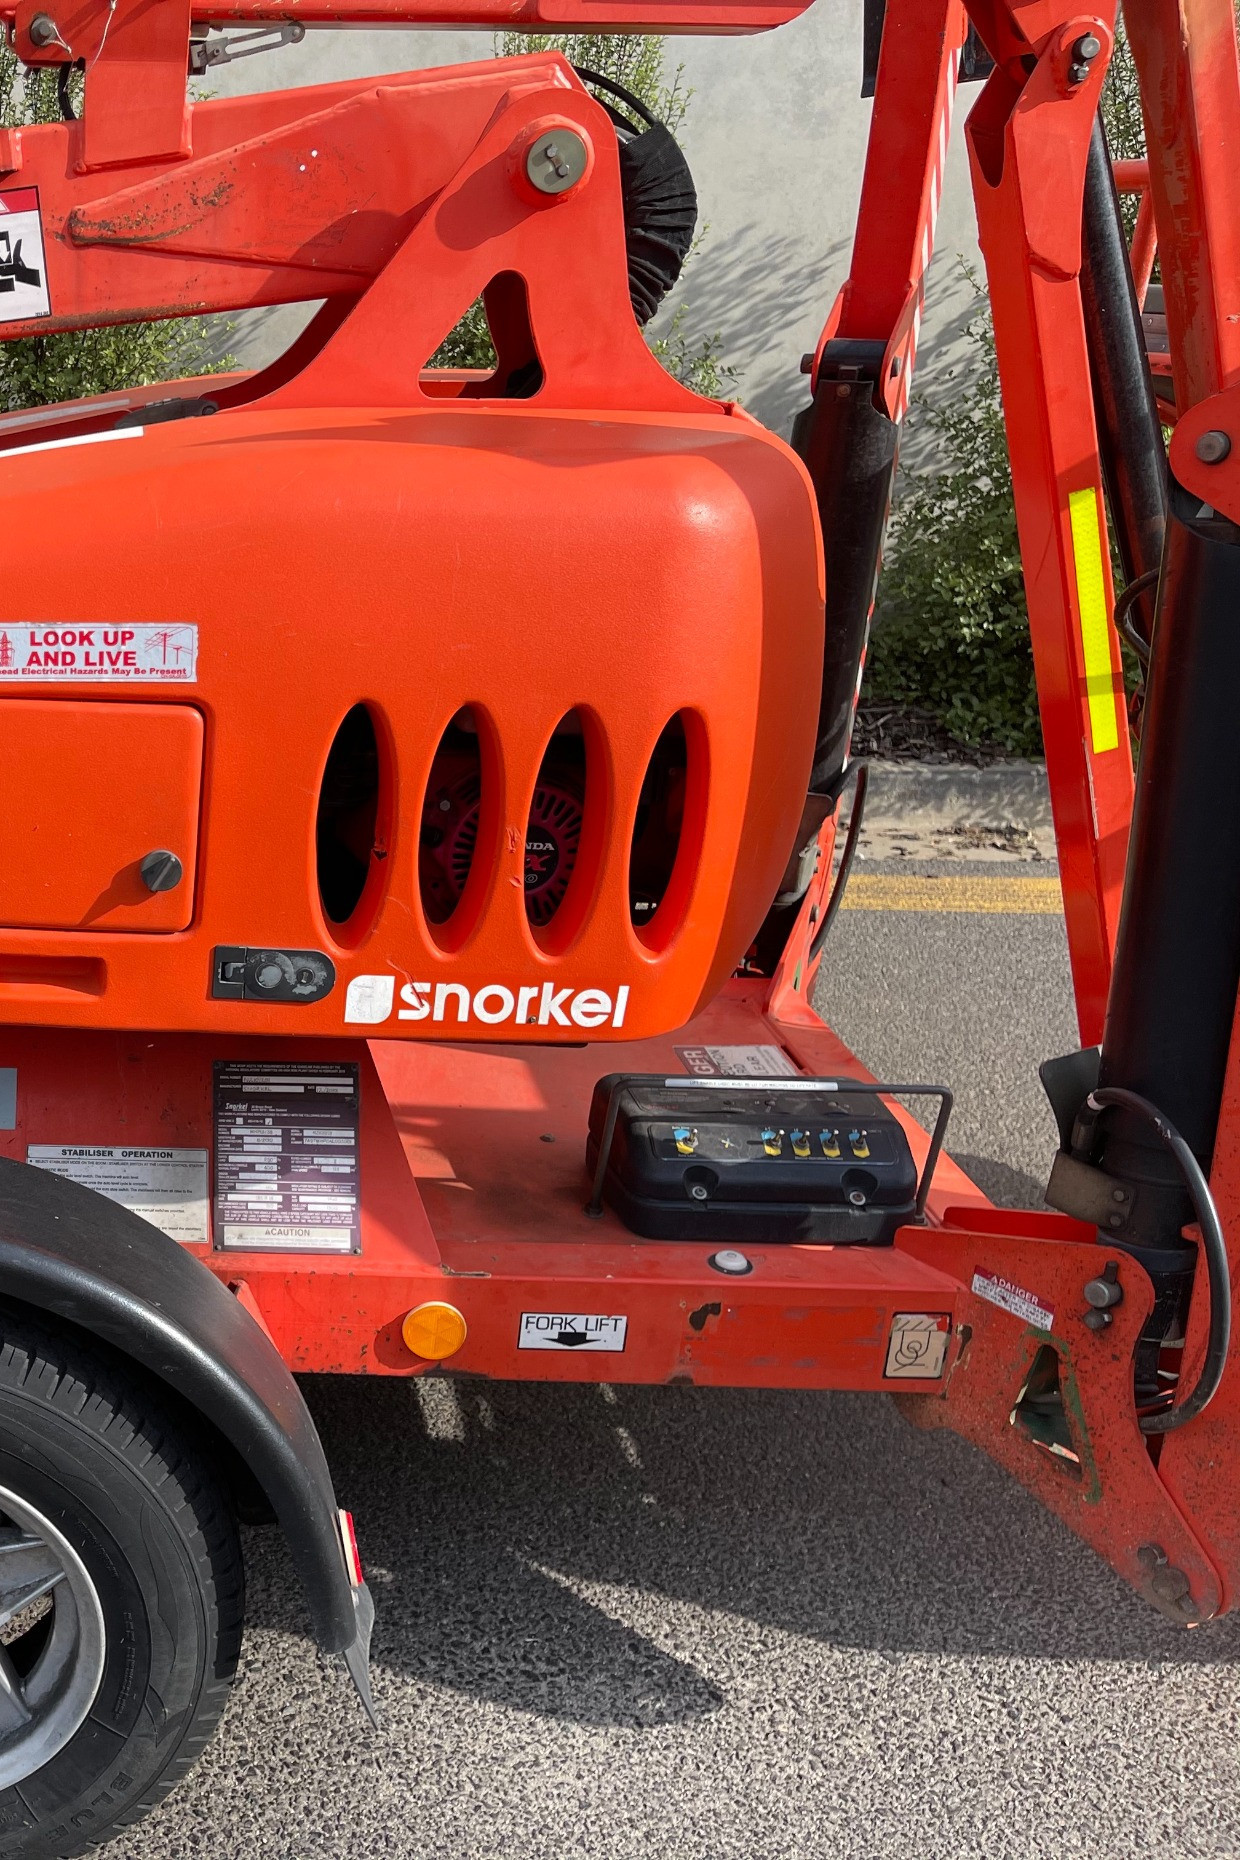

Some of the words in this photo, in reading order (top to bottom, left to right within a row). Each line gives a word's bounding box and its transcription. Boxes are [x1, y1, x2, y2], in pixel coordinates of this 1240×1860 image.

[30, 631, 95, 647] LOOK
[103, 631, 135, 646] UP
[27, 651, 77, 666] AND
[84, 651, 136, 666] LIVE
[21, 667, 67, 675] Electrical
[70, 667, 109, 675] Hazards
[112, 668, 131, 677] May
[134, 667, 147, 675] Be
[149, 667, 187, 676] Present
[397, 982, 630, 1028] snorkel
[61, 1149, 114, 1157] STABILISER
[121, 1150, 173, 1159] OPERATION
[998, 1278, 1039, 1305] DANGER
[525, 1315, 577, 1332] FORK
[584, 1317, 622, 1332] LIFT
